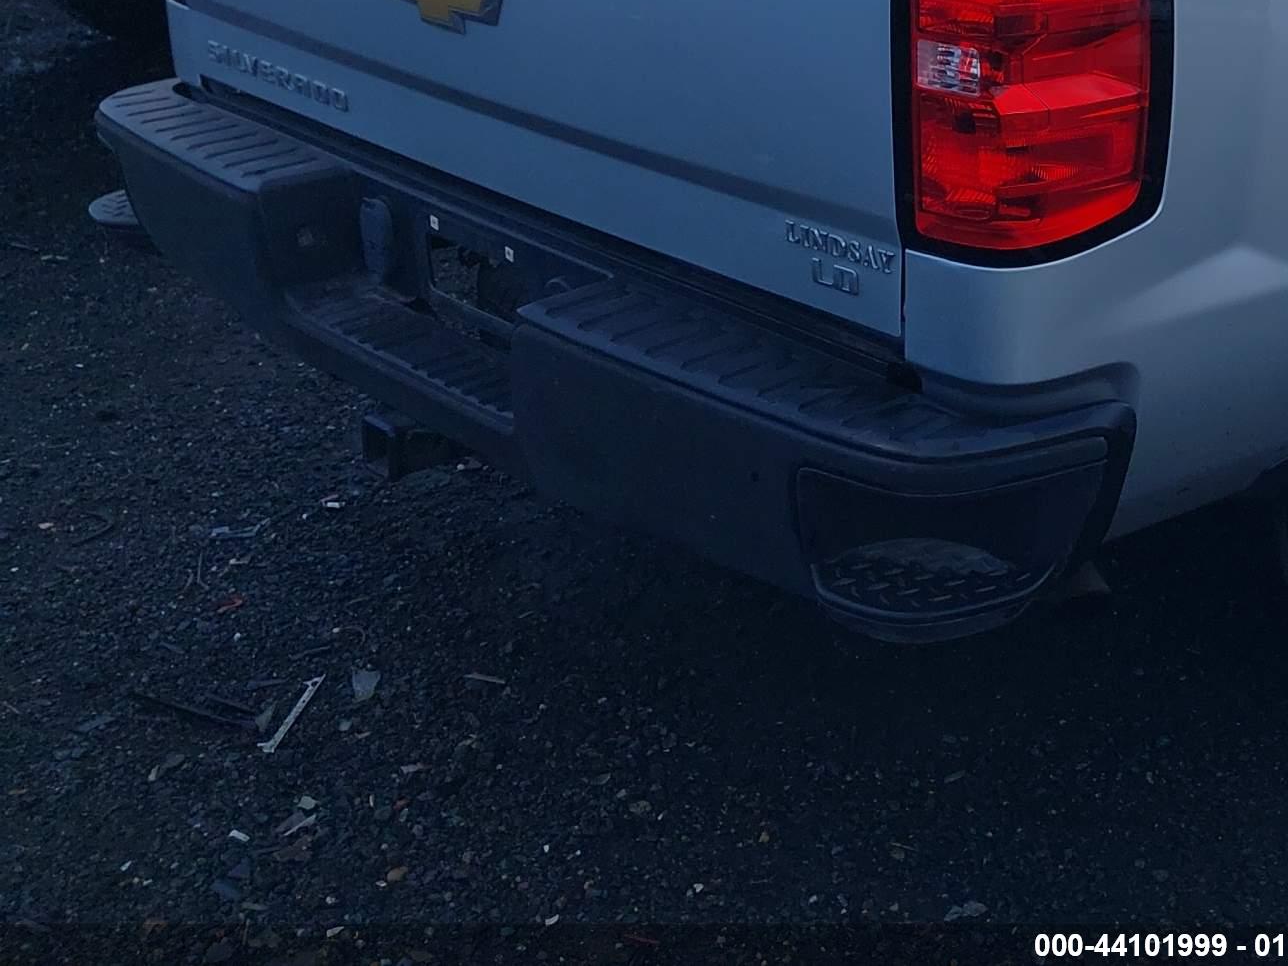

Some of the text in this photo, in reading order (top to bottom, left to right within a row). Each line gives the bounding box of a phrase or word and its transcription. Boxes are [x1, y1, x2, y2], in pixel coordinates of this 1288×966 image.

[207, 40, 350, 112] SILVERADO
[785, 219, 896, 274] LINDSAY
[811, 257, 860, 295] LD
